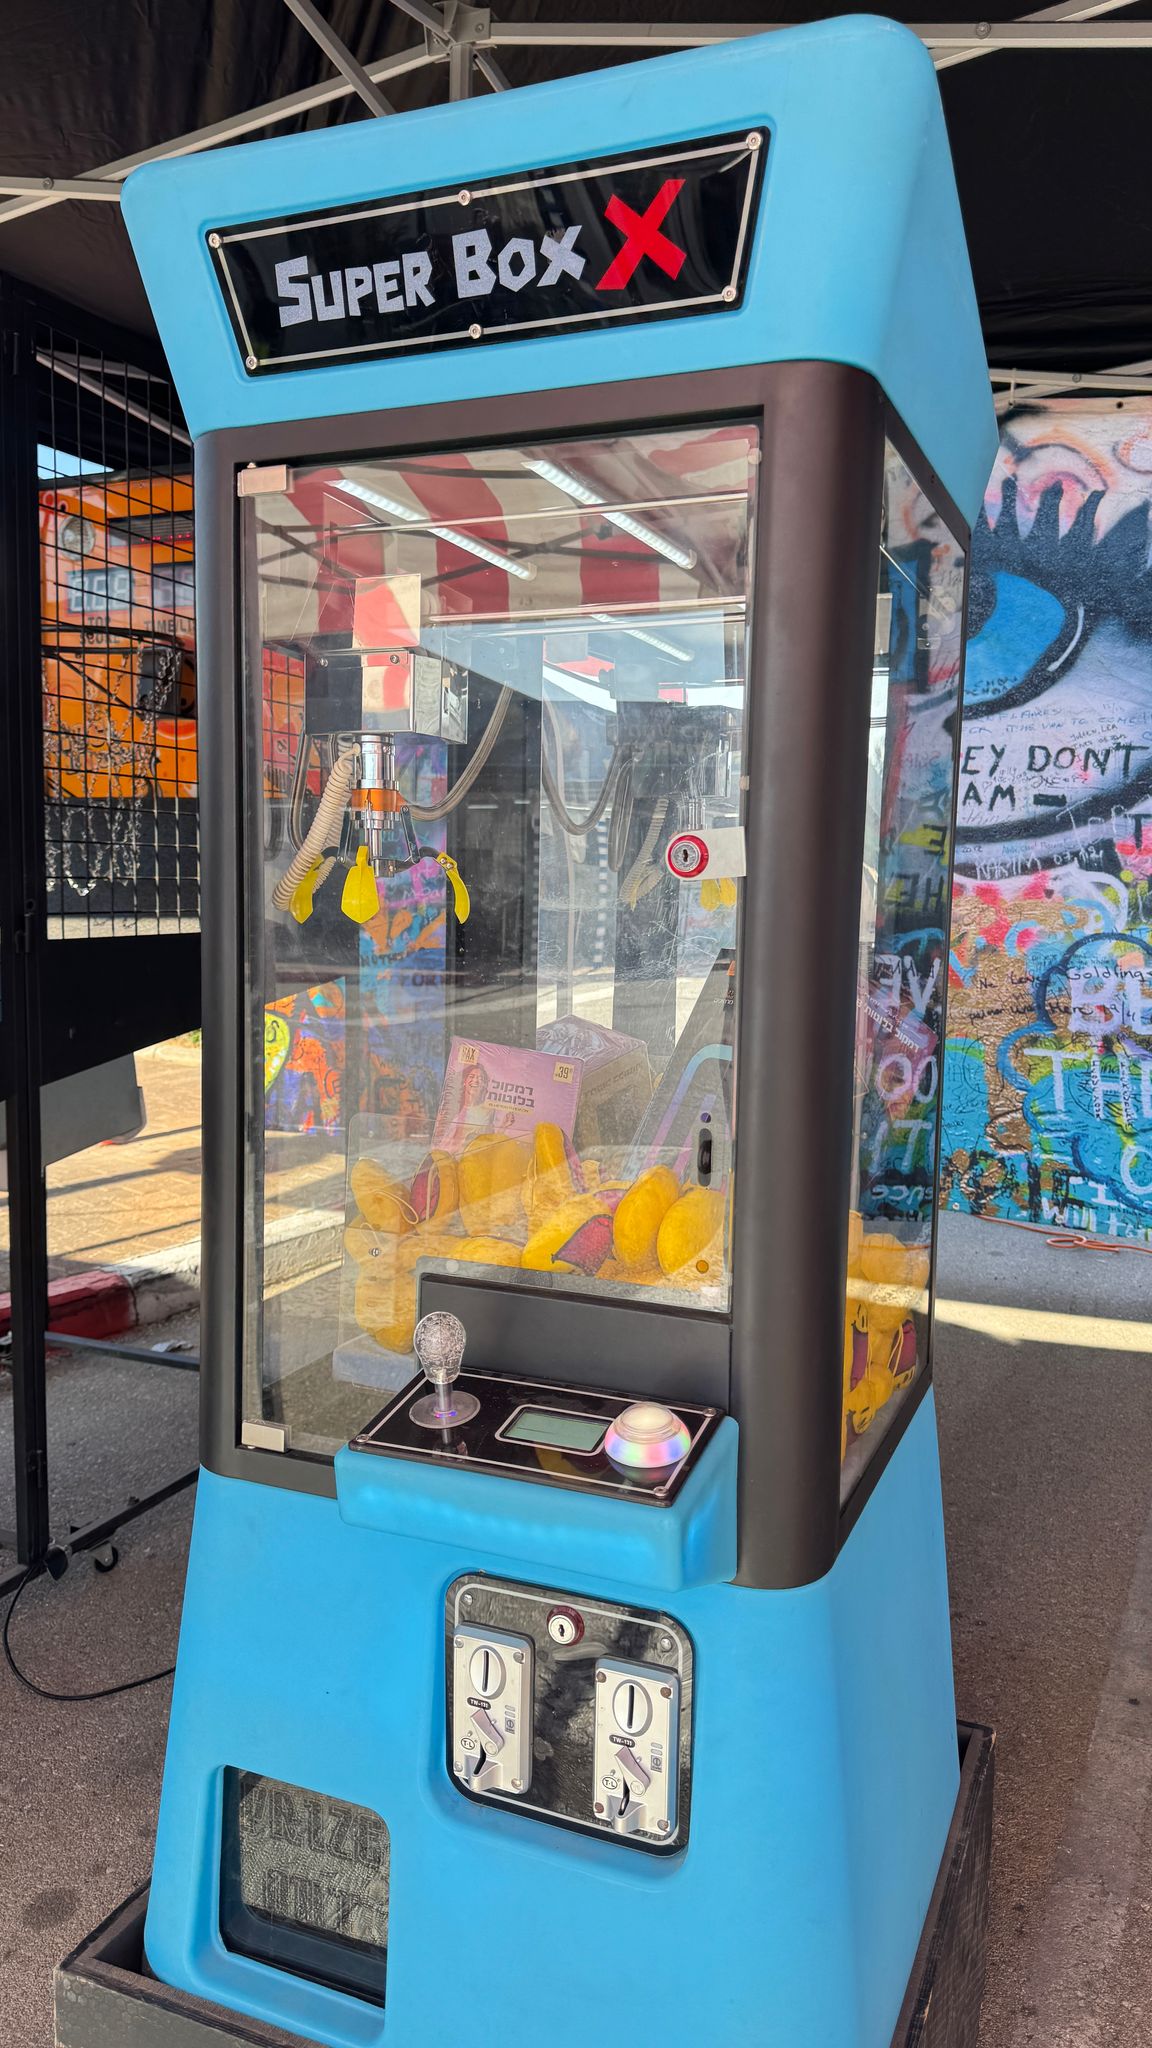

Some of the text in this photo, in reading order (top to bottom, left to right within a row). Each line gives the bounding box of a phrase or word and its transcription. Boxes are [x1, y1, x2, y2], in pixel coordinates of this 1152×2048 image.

[275, 178, 687, 328] SUPER BOX X
[491, 1079, 534, 1096] רמקול
